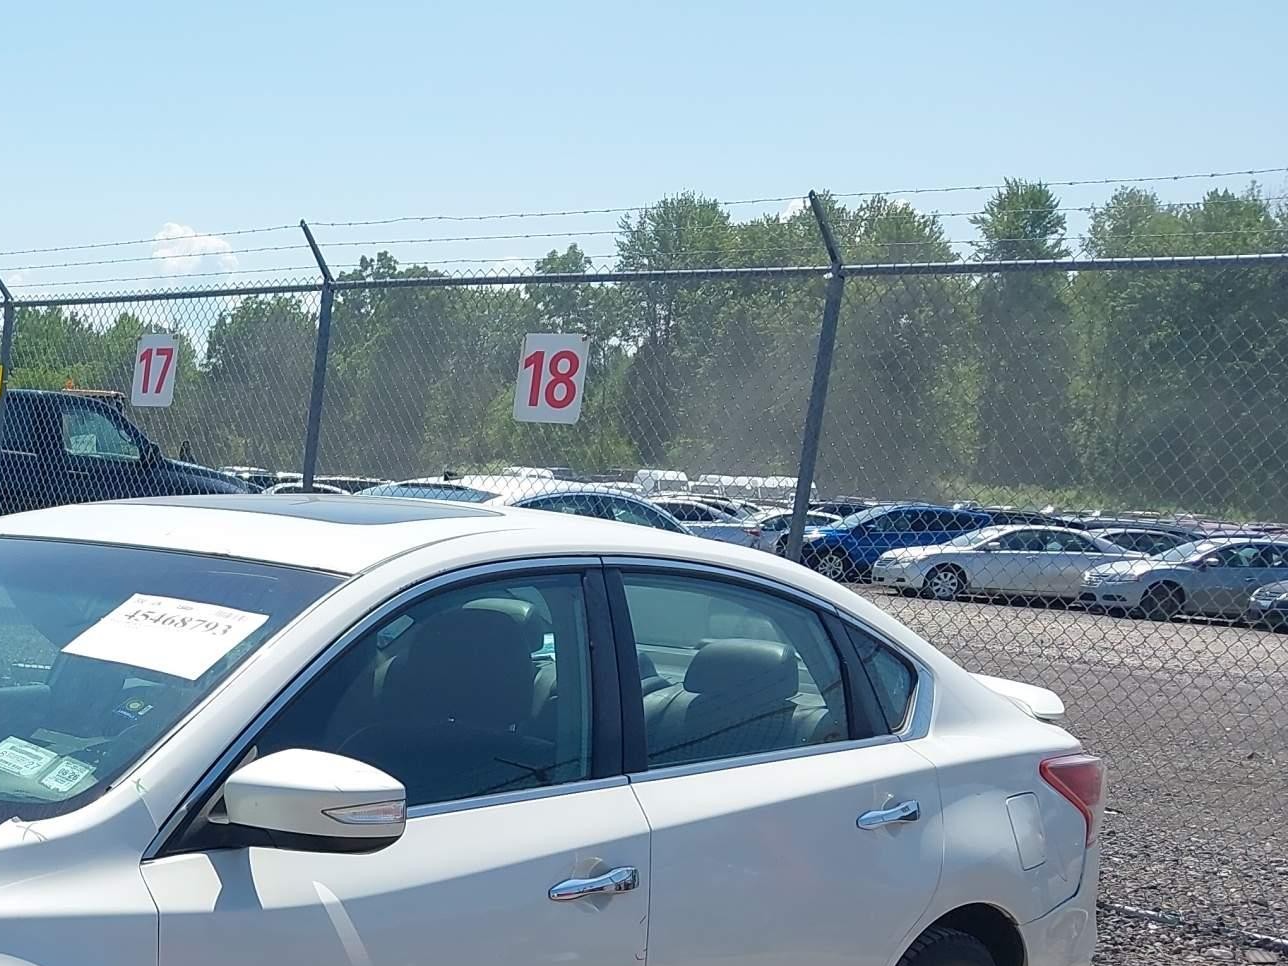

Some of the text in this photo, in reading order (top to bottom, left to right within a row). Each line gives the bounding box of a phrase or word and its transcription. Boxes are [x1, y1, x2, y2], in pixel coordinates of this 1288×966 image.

[139, 347, 174, 394] 17
[523, 350, 580, 409] 18
[124, 609, 233, 636] 45468793
